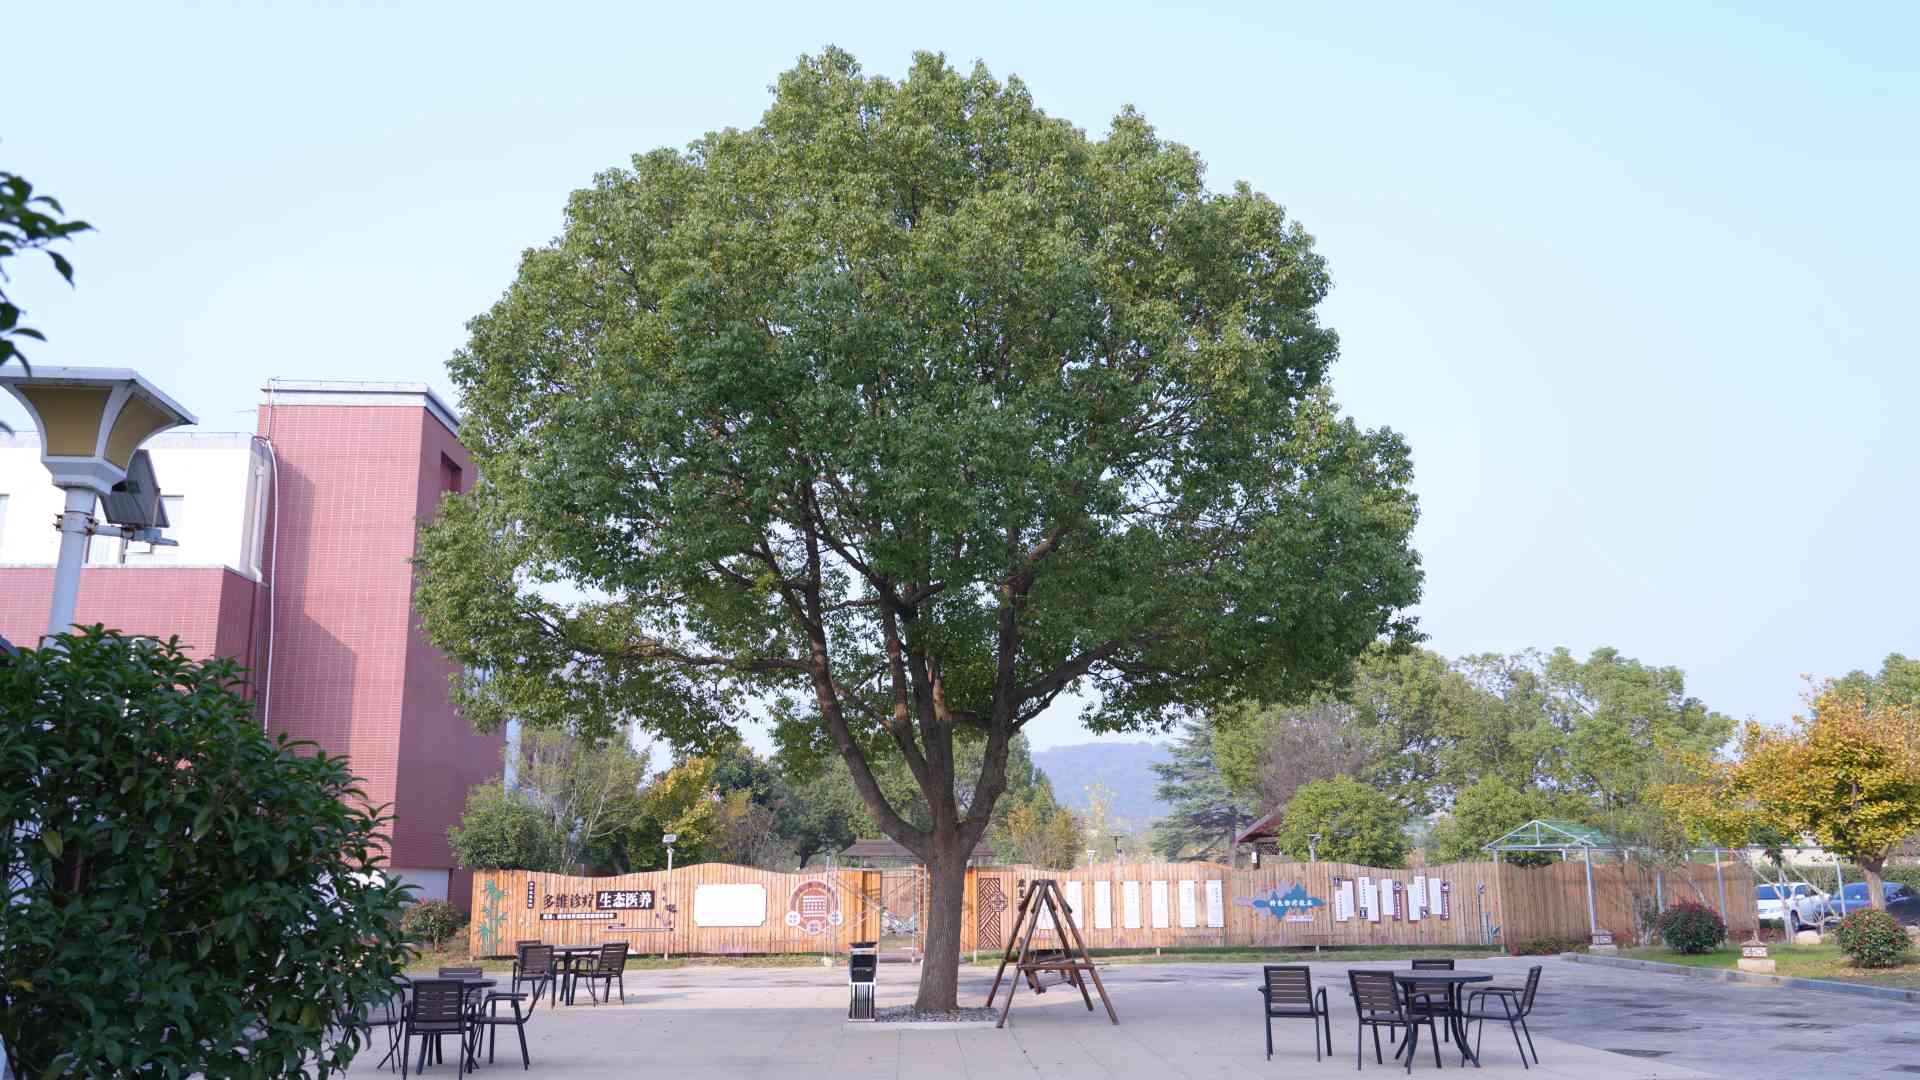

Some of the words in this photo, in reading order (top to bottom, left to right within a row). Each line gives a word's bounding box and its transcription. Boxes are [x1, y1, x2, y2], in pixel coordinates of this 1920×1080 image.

[543, 893, 594, 909] 多维诊疗
[599, 892, 652, 908] 生态医养
